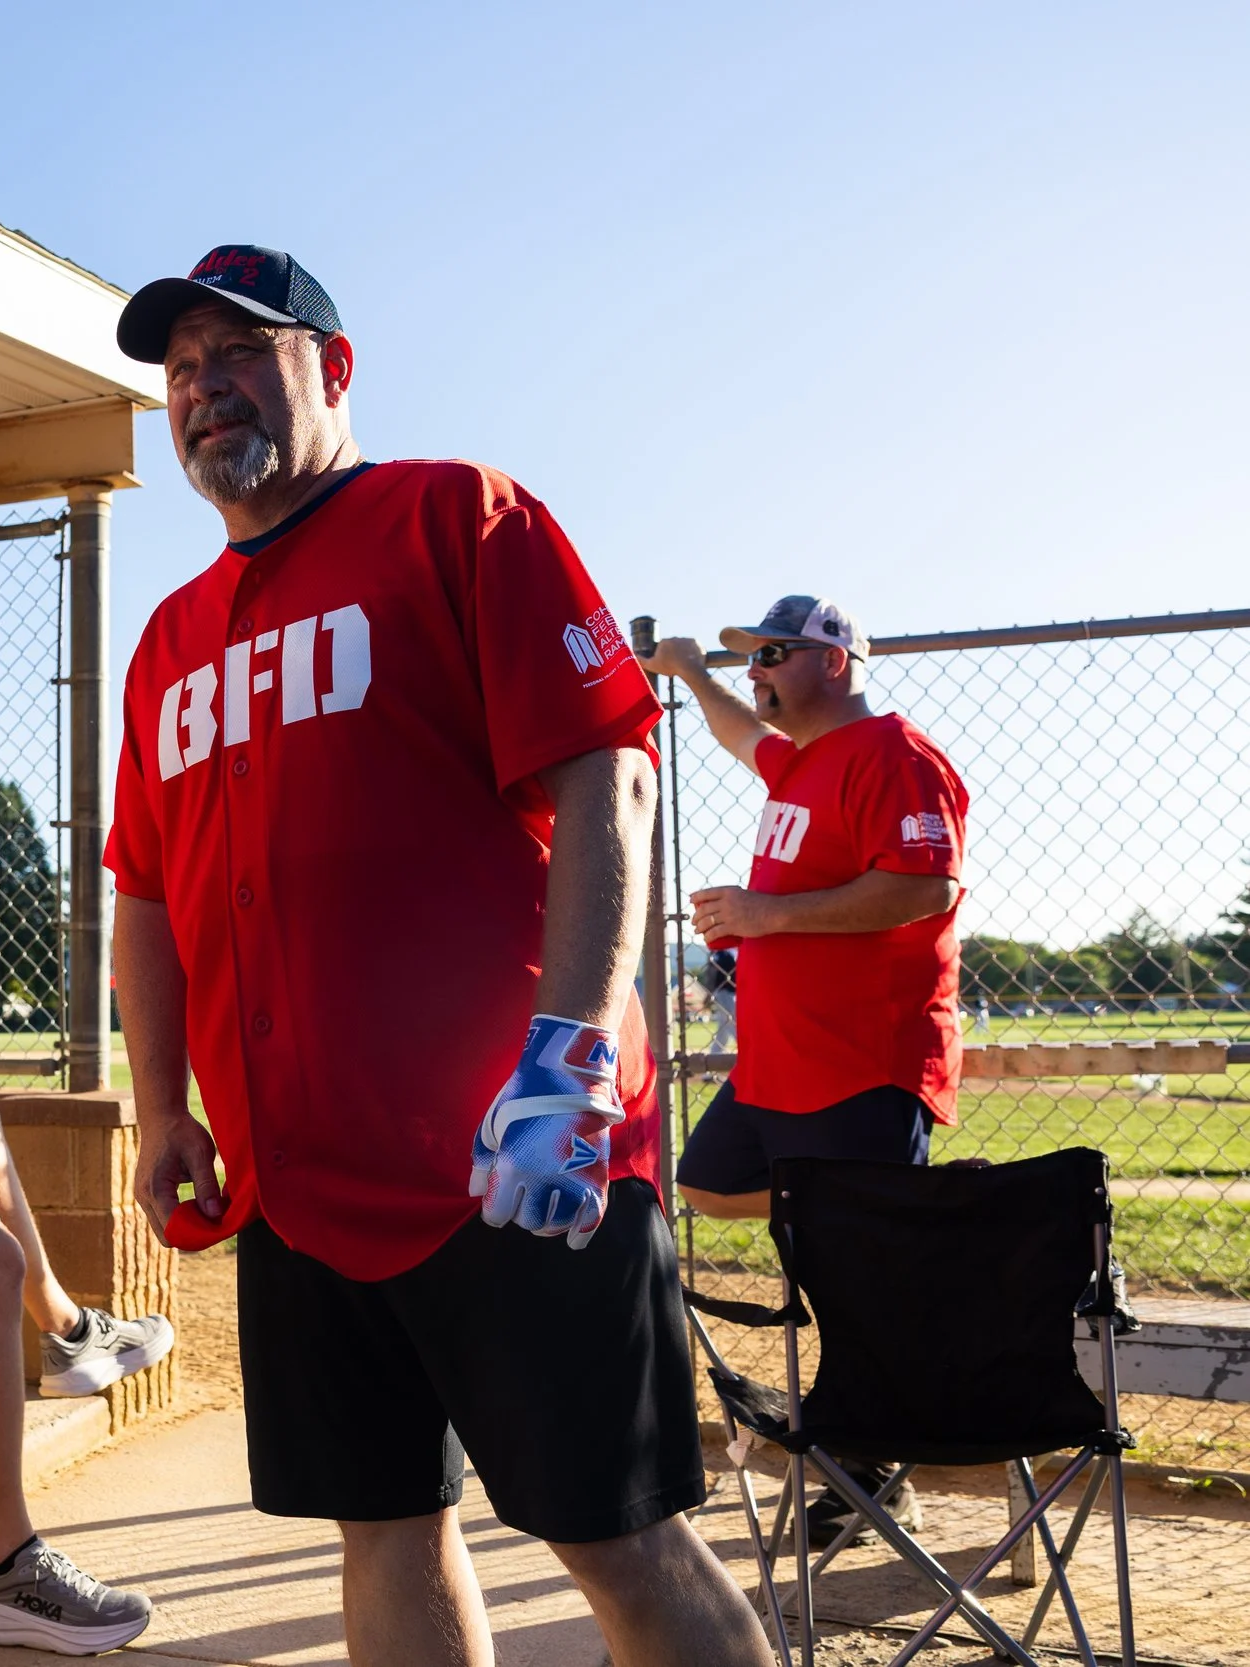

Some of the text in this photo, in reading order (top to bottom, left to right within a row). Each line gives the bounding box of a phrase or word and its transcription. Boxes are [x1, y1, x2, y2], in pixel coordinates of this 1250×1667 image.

[239, 267, 260, 287] 2
[158, 603, 372, 782] BFD
[13, 1591, 63, 1621] HOKA
